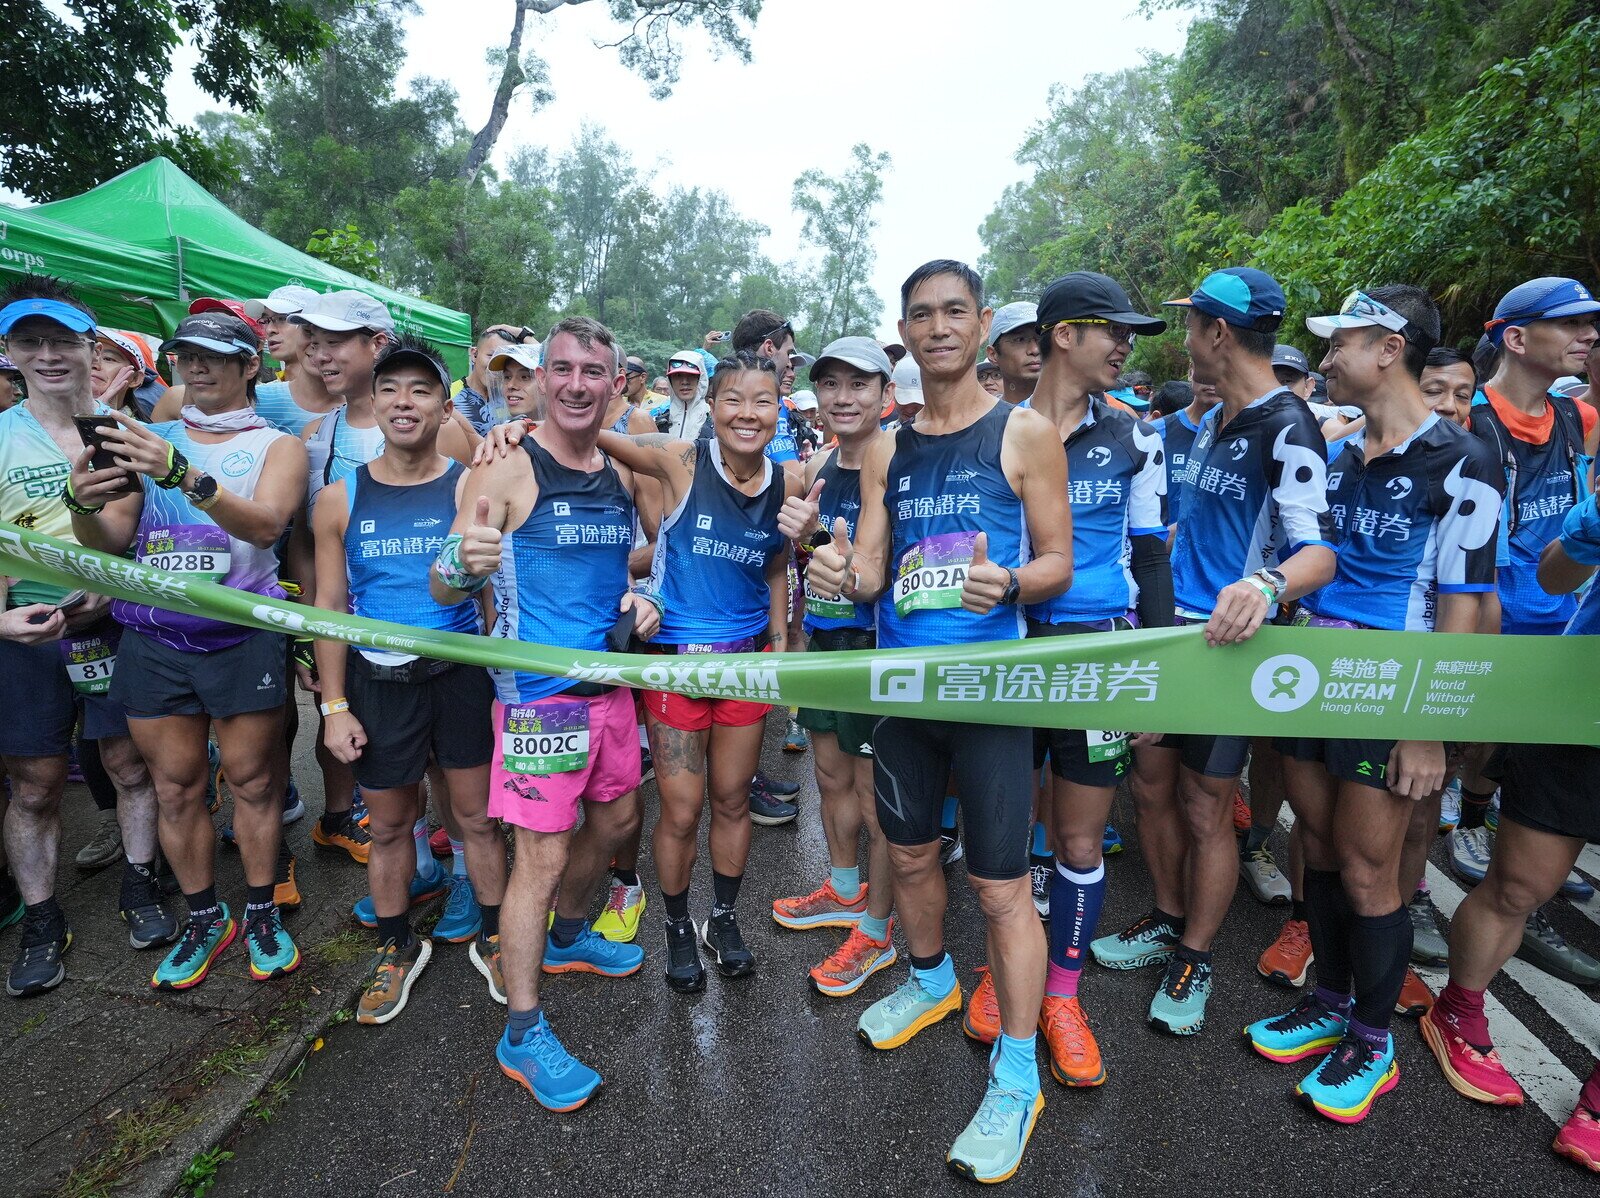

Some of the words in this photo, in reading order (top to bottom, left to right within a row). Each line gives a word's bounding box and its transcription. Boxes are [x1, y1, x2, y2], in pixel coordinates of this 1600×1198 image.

[164, 465, 186, 488] LEKI
[1186, 458, 1247, 501] 途證券
[1068, 479, 1121, 504] 證券
[897, 493, 980, 520] 富途證券
[1518, 493, 1573, 521] 途證券
[555, 524, 631, 544] 富途證券
[360, 536, 445, 558] 富途證券
[692, 536, 766, 567] 富途證券
[150, 555, 215, 571] 8028B
[901, 568, 967, 596] 8002A
[386, 635, 416, 648] World
[641, 666, 780, 690] OXFAM
[1329, 658, 1403, 680] 樂施會
[1433, 660, 1493, 676] 無窮世界
[937, 659, 1160, 702] 富途證券
[1323, 682, 1397, 700] OXFAM
[1430, 679, 1466, 691] World
[647, 684, 782, 700] TRAILWALKER
[1425, 692, 1475, 704] Without
[1320, 702, 1351, 715] Hong
[1353, 702, 1385, 716] Kong
[1420, 704, 1469, 717] Poverty
[513, 735, 578, 755] 8002C
[1072, 888, 1085, 946] COMPRESSPORT
